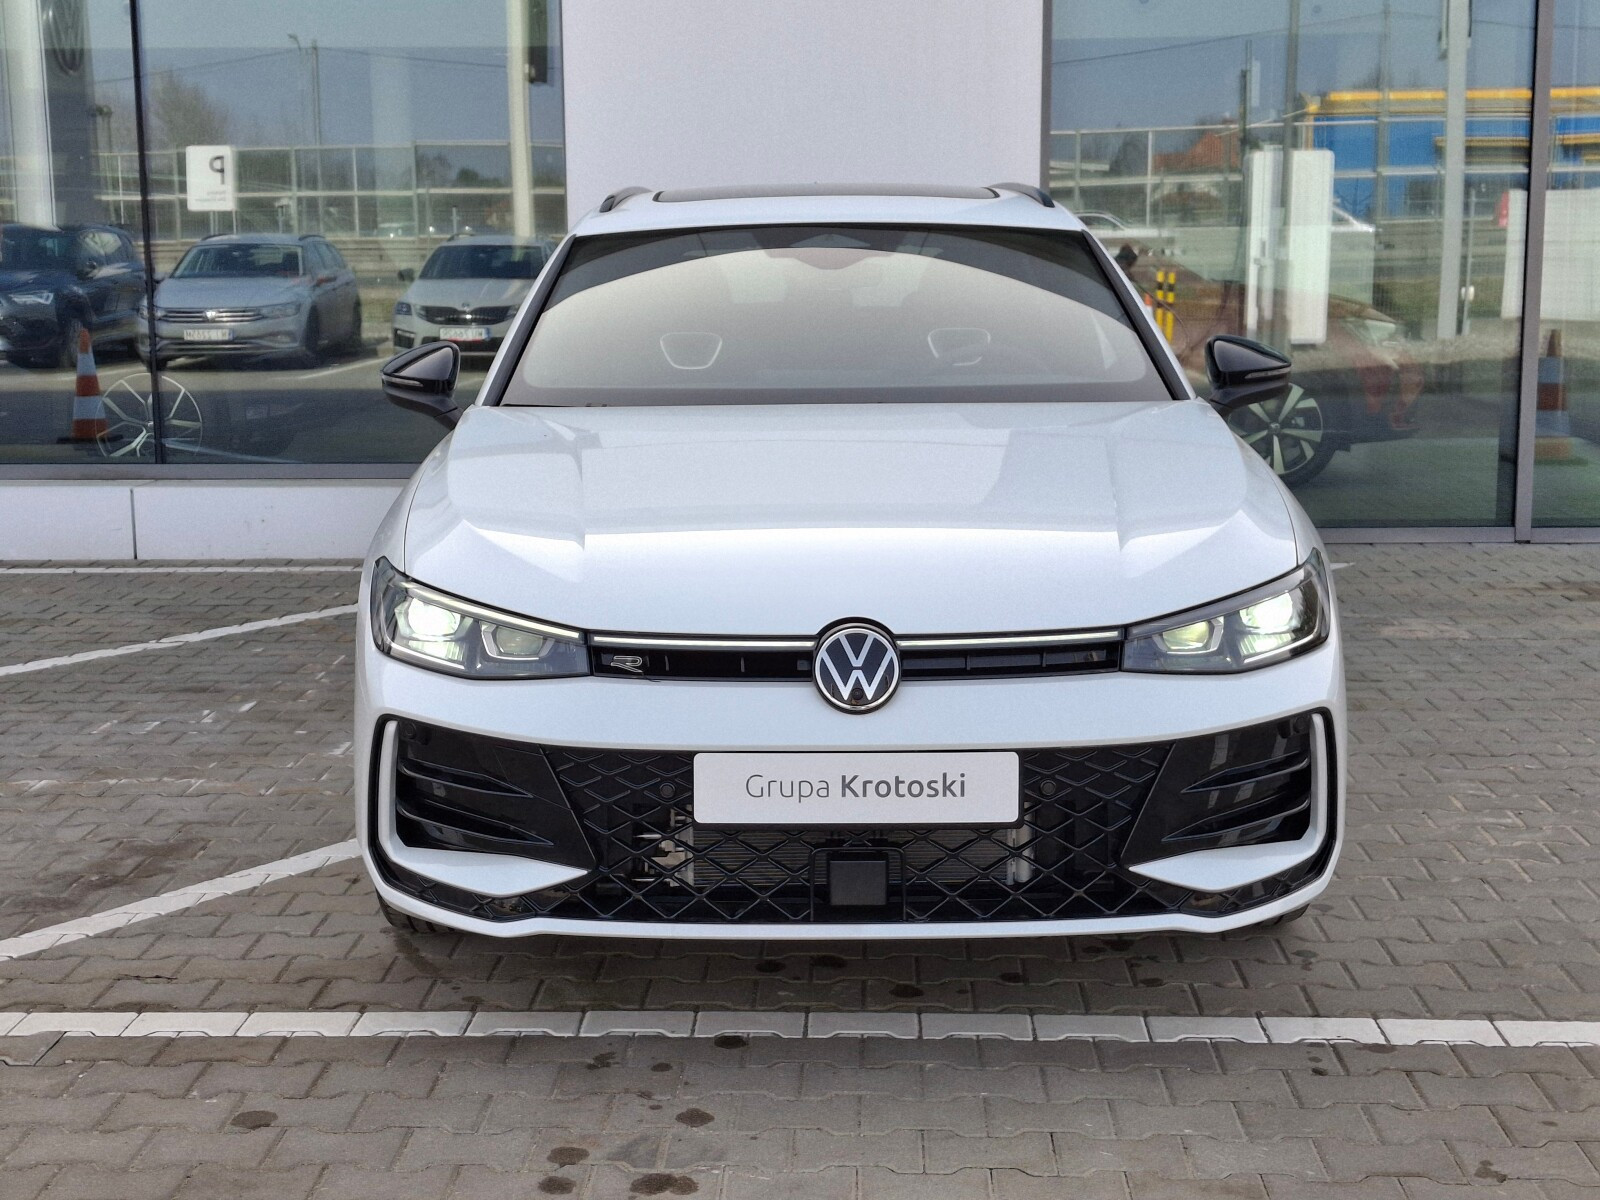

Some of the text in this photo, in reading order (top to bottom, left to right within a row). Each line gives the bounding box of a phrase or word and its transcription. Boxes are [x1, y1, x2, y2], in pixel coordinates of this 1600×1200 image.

[819, 630, 894, 702] VW
[745, 772, 966, 804] Grupa Krotoski
